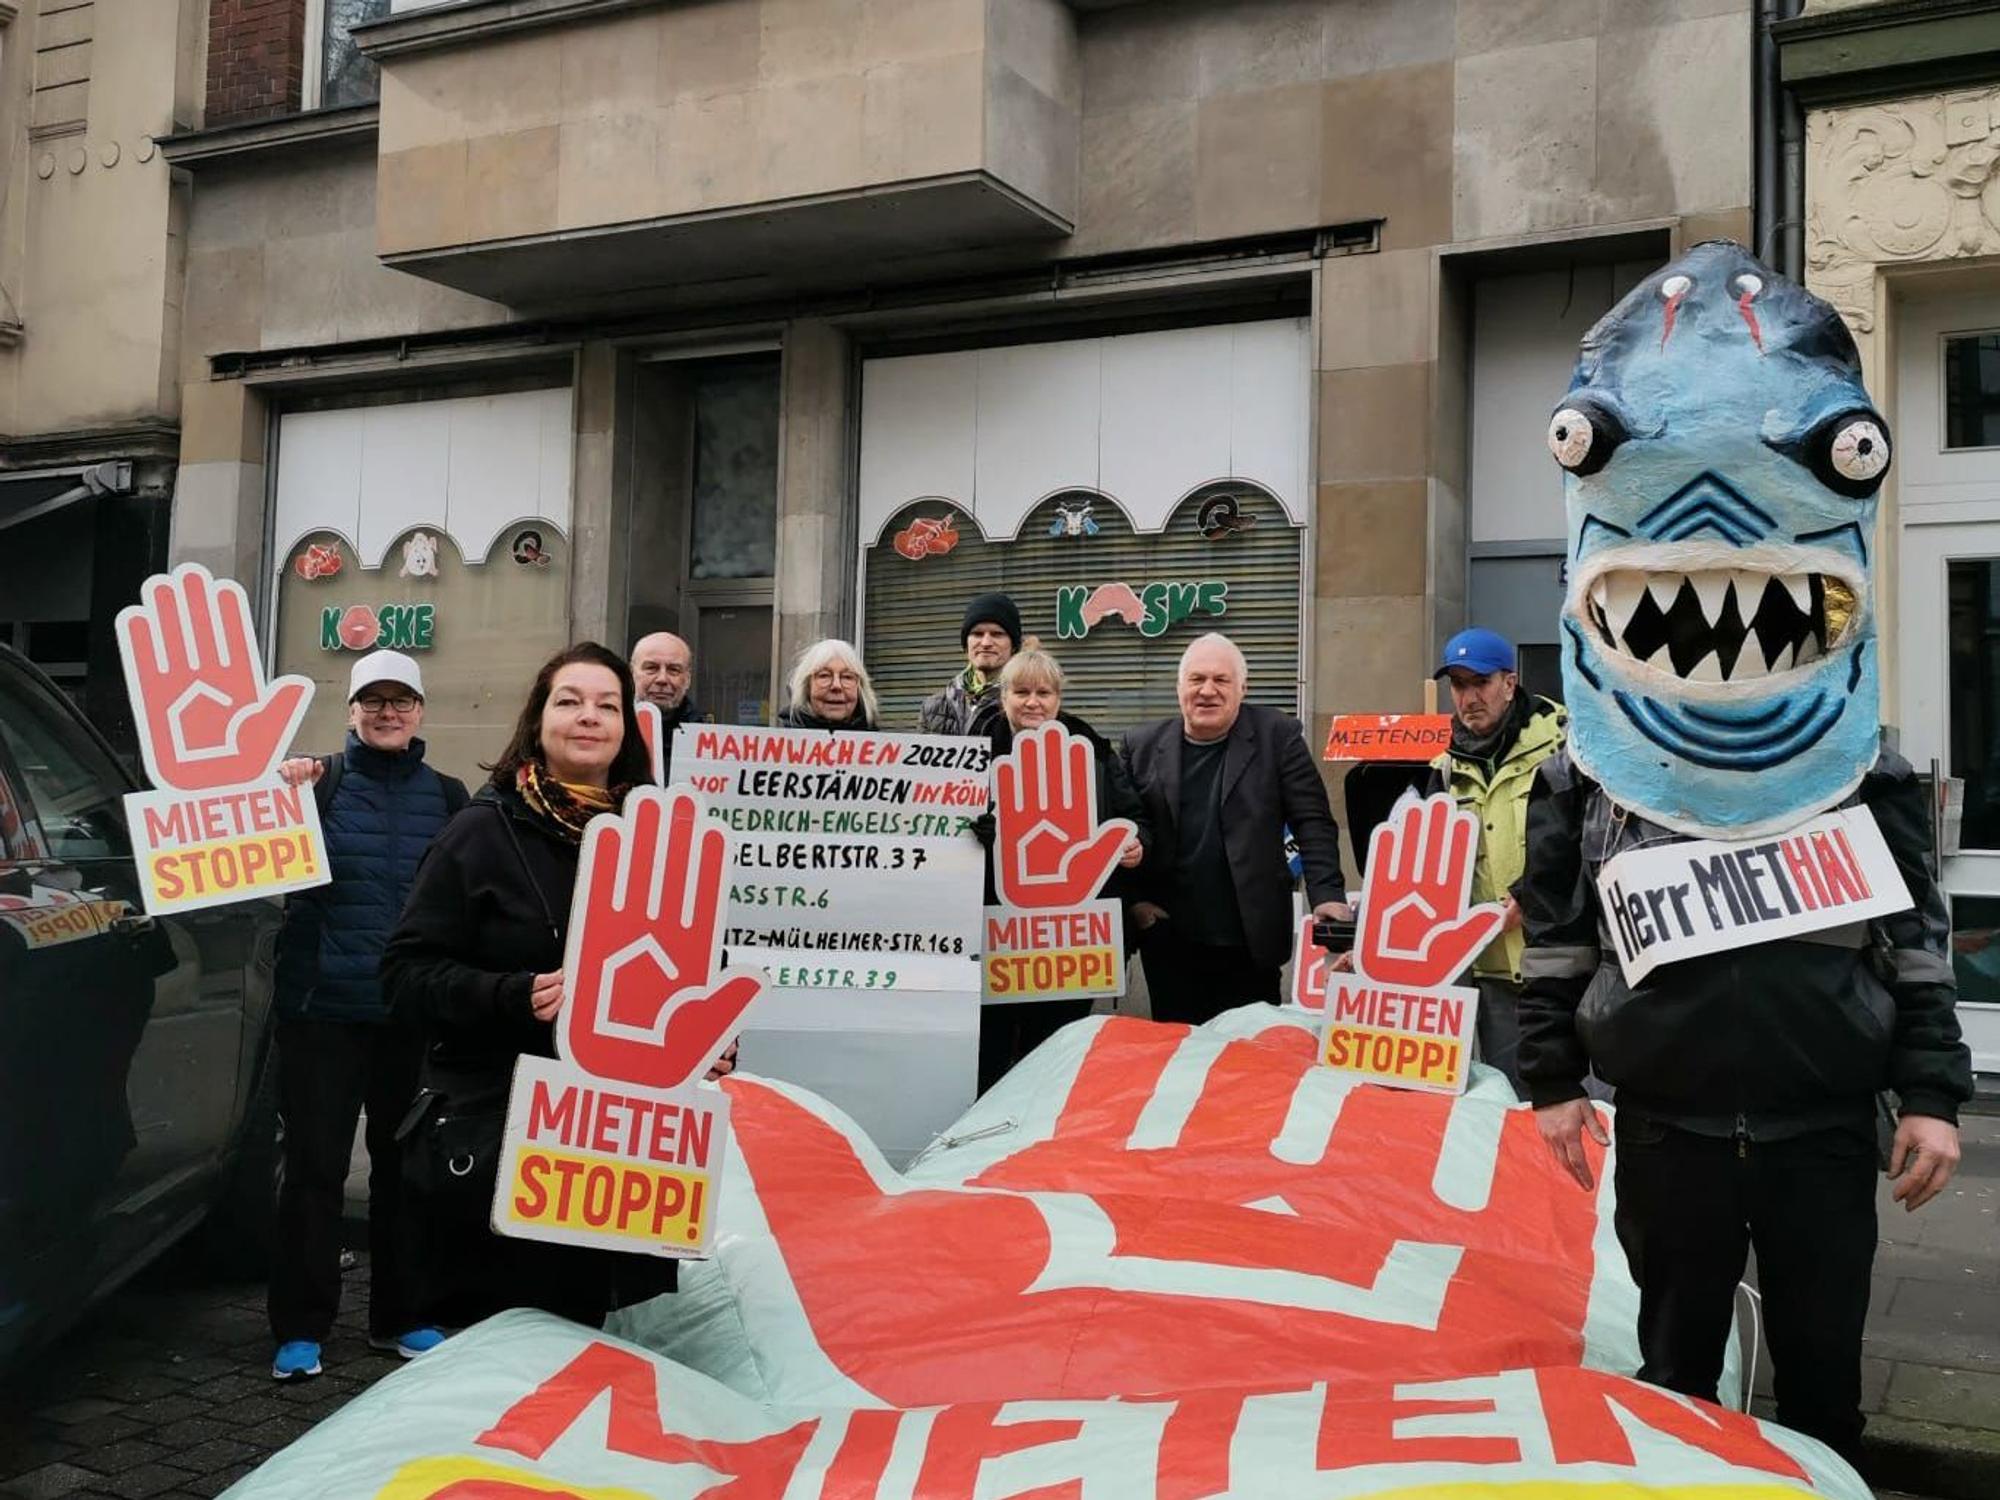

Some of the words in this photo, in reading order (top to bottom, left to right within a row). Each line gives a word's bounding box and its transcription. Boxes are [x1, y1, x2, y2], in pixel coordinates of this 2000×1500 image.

[320, 604, 435, 650] KOSKE
[696, 732, 901, 766] MAHNWACHEN
[902, 744, 990, 772] 2022/23
[1330, 728, 1451, 744] MIETENDE
[738, 769, 912, 804] LEERSTÄNDEN
[912, 783, 942, 804] IN
[143, 783, 304, 849] MIETEN
[154, 834, 314, 899] STOPP!
[733, 843, 927, 870] ELBERTSTR.37
[1608, 880, 1695, 962] Herr
[1689, 827, 1873, 931] MIETHAI
[988, 912, 1111, 952] MIETEN
[989, 952, 1113, 993] STOPP!
[1335, 986, 1464, 1037] MIETEN
[1328, 1029, 1458, 1082] STOPP!
[526, 1080, 713, 1169] MIETEN
[514, 1154, 704, 1241] STOPP!
